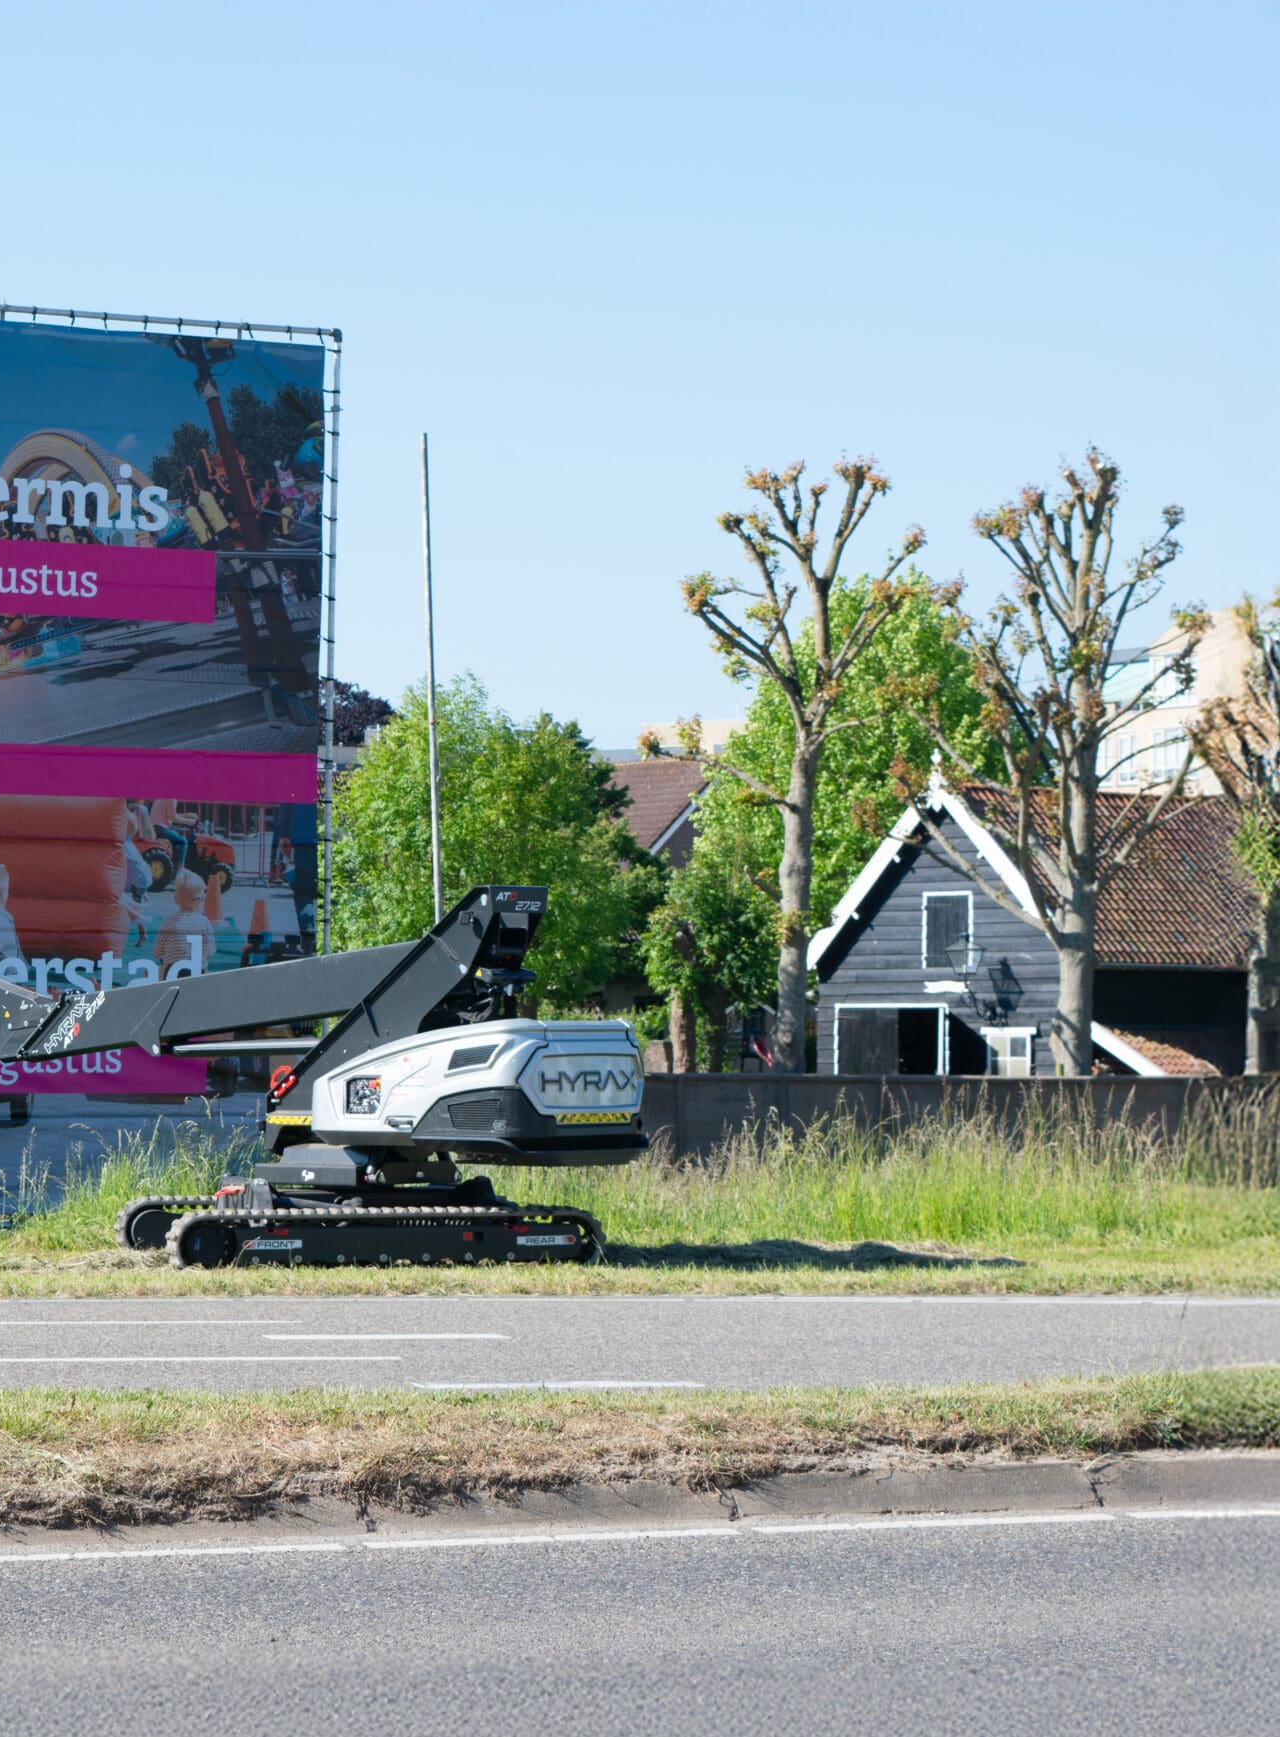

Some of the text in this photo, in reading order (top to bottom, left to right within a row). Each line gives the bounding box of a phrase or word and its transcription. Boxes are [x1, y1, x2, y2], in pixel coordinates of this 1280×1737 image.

[43, 995, 90, 1054] HYRAX
[539, 1070, 636, 1092] HYRAX
[257, 1240, 296, 1248] FRONT
[525, 1236, 556, 1244] REAR
